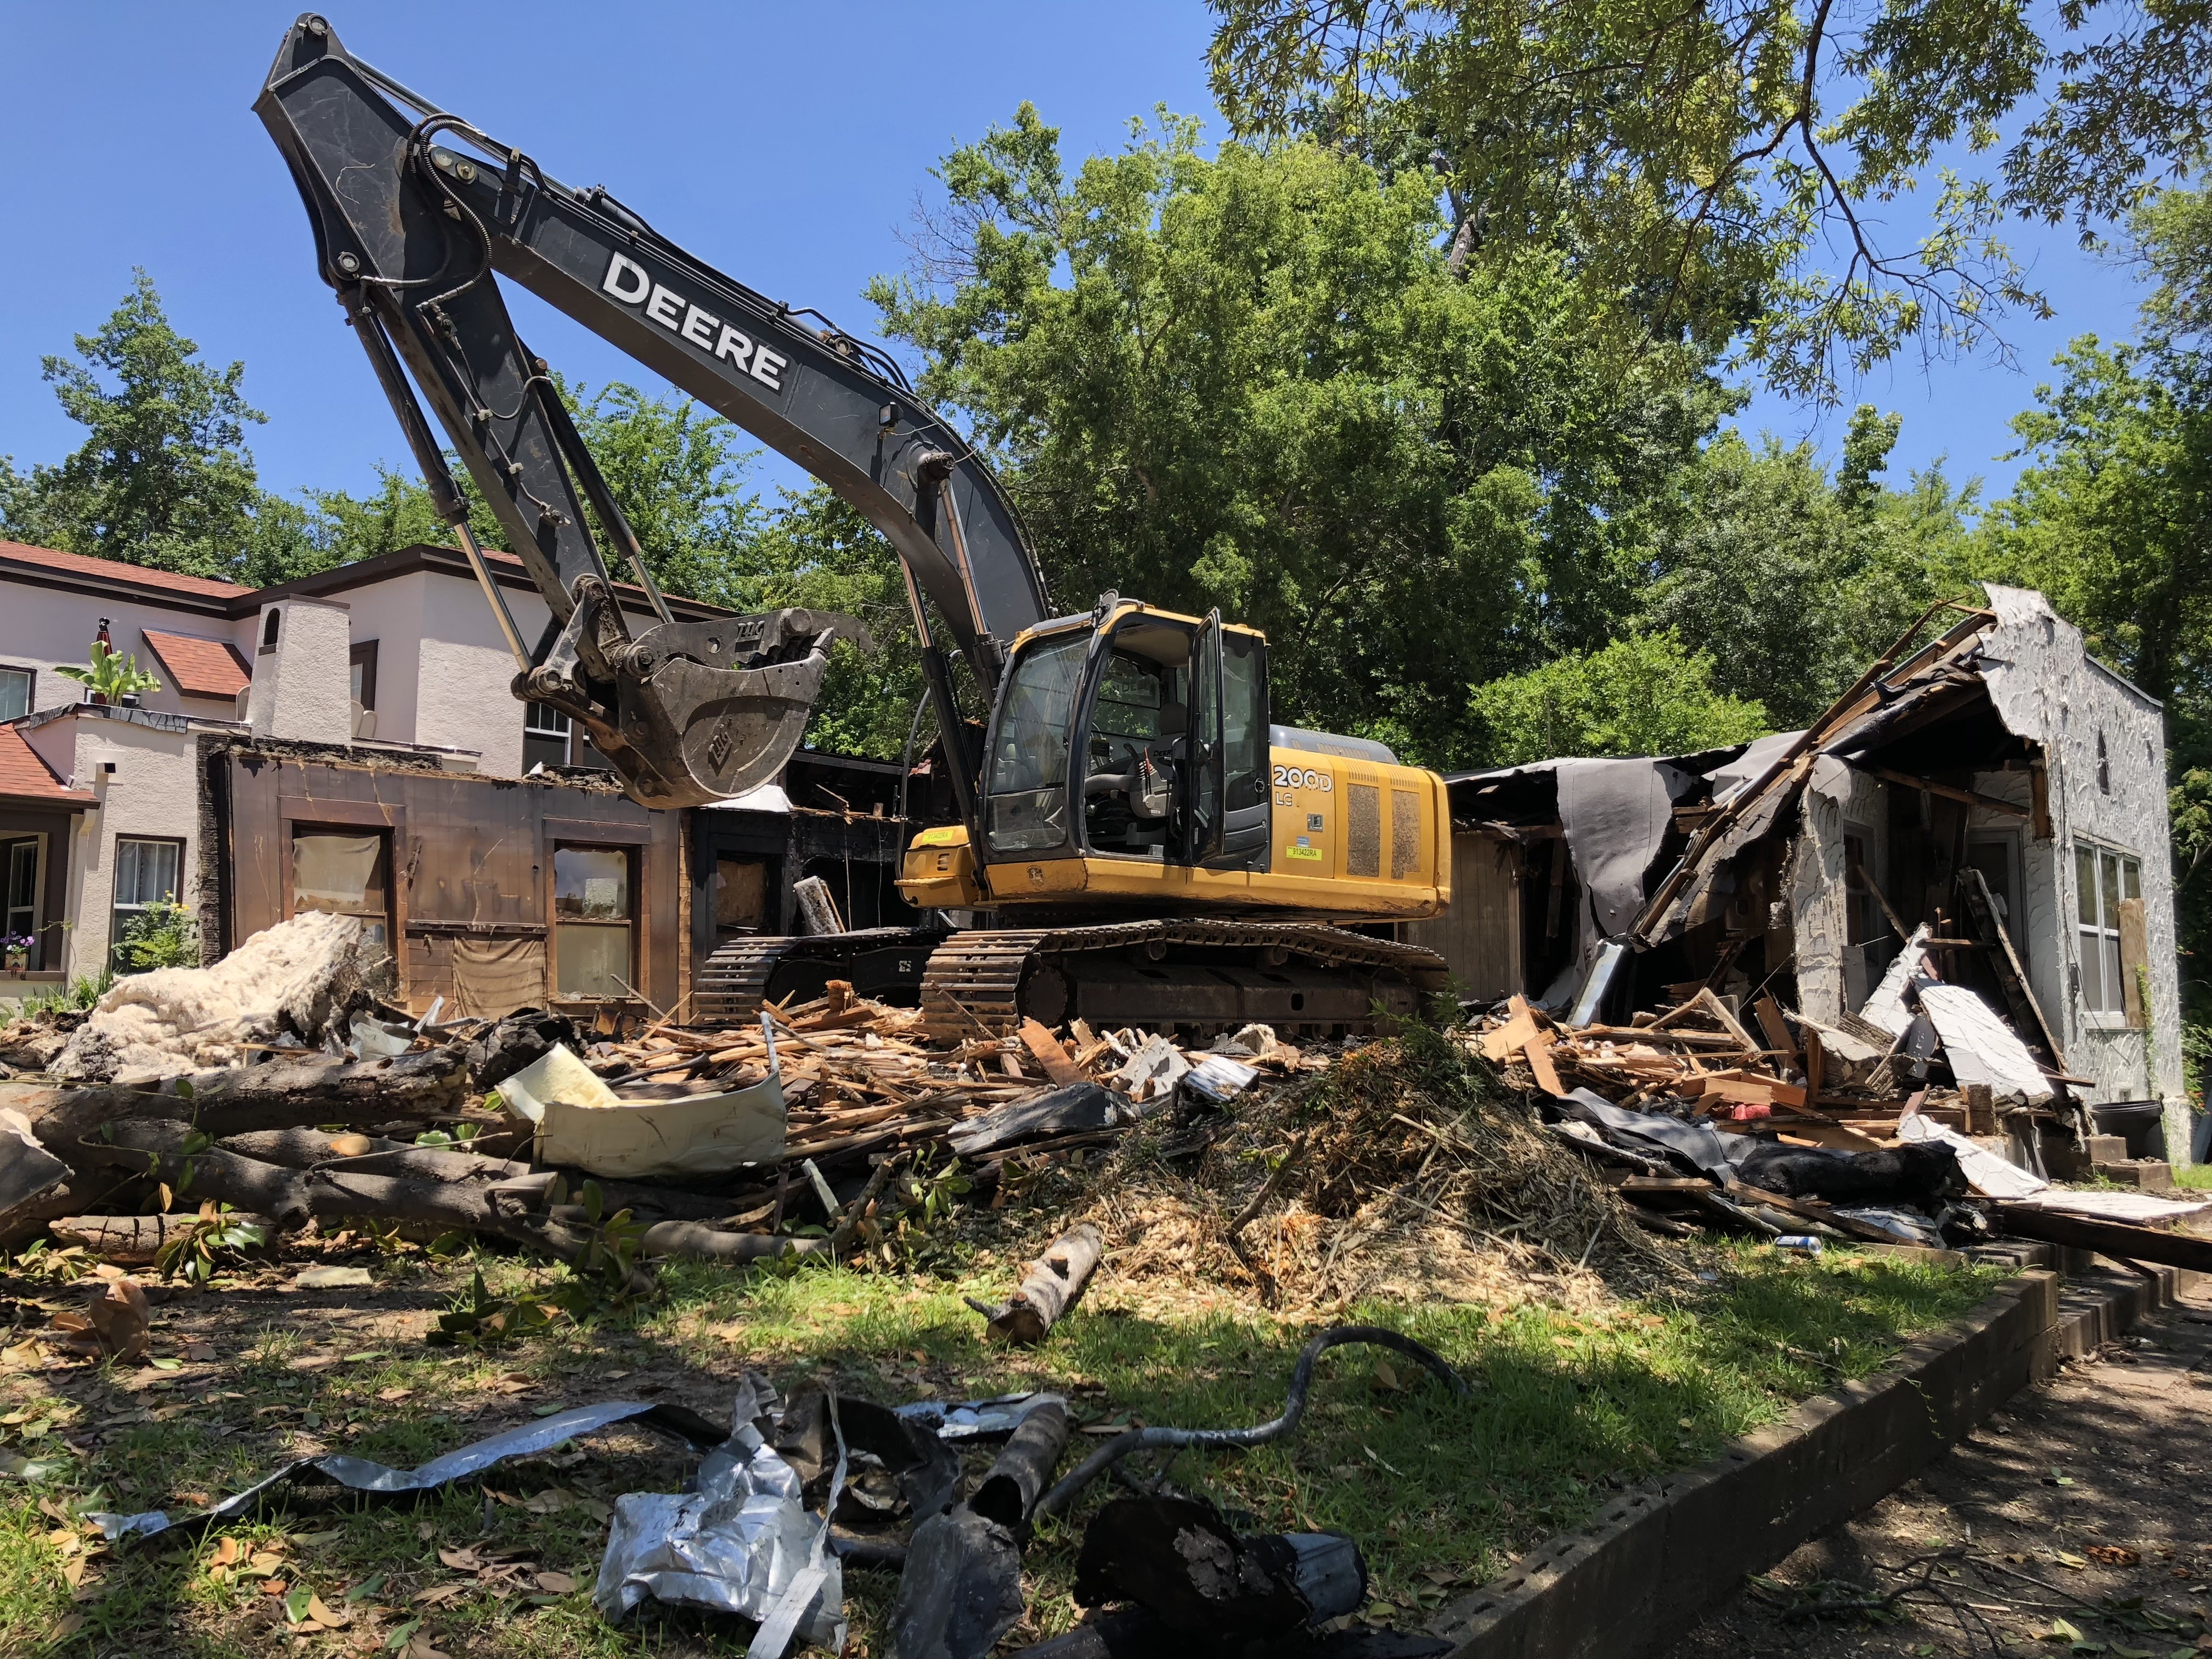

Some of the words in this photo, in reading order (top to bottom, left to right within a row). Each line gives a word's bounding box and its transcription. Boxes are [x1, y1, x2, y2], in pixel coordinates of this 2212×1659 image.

[602, 251, 787, 391] DEERE
[1273, 765, 1332, 792] 200D
[1276, 792, 1292, 806] LC
[1293, 848, 1317, 857] 913422RA
